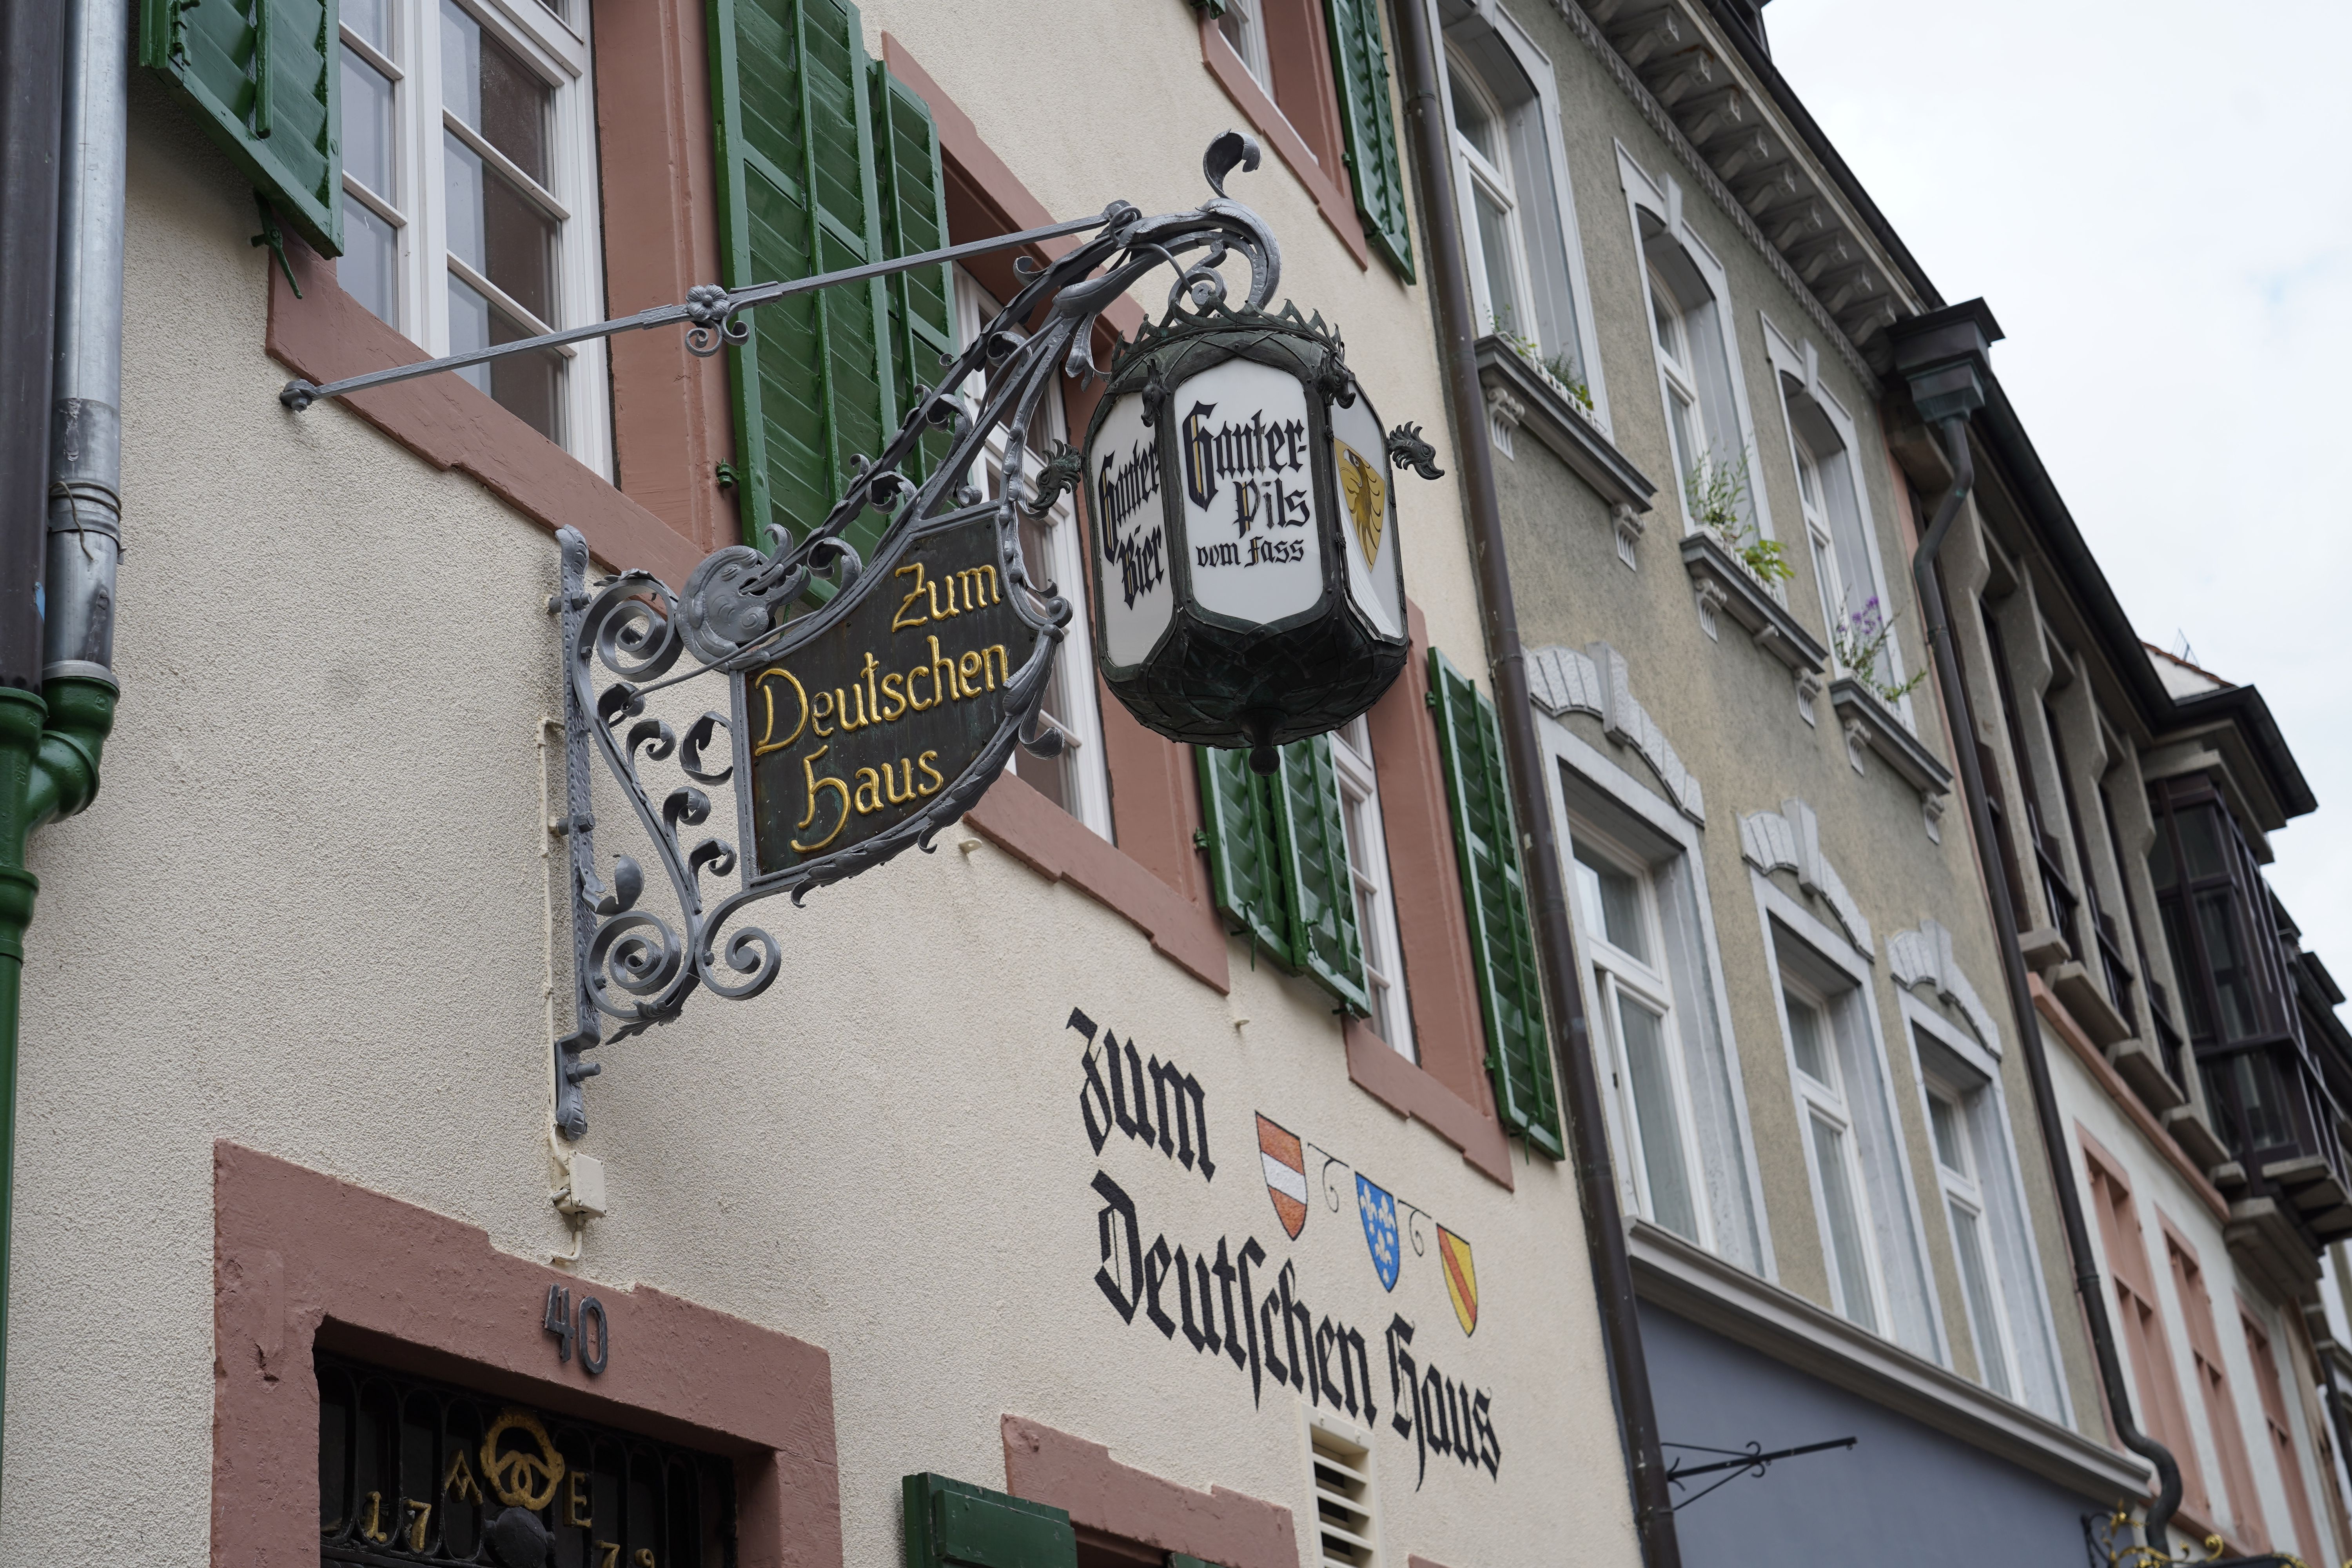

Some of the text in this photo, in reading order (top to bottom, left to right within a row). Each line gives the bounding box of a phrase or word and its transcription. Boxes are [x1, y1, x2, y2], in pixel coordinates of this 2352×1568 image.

[1196, 535, 1304, 568] vom Fass
[1232, 477, 1310, 539] Pils
[892, 562, 1001, 633] Zum
[1116, 524, 1164, 611] Bier
[755, 635, 1009, 756] Deutschen
[1065, 1007, 1216, 1183] Zum
[544, 1282, 608, 1374] 40
[1385, 1312, 1501, 1492] Haus
